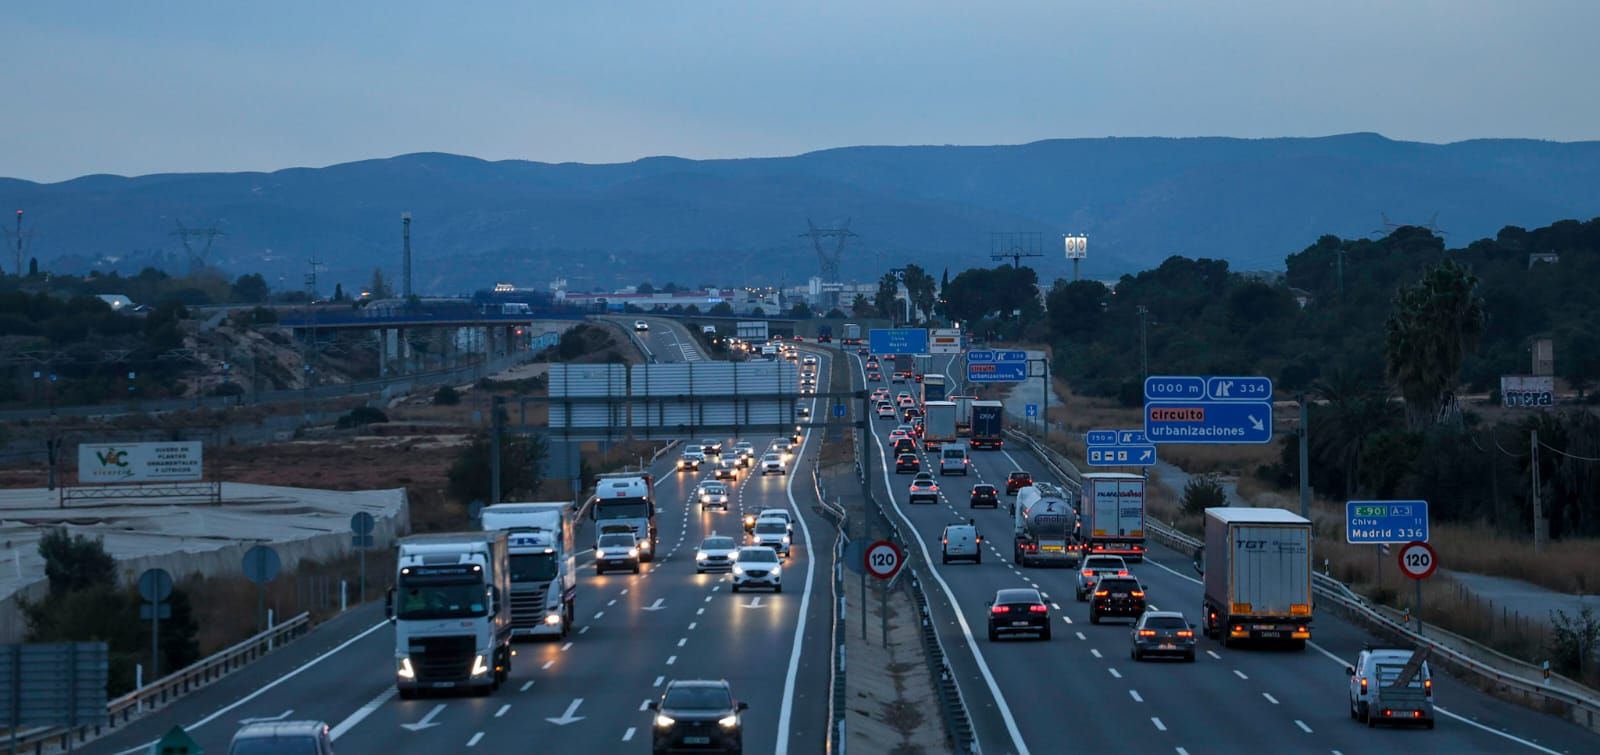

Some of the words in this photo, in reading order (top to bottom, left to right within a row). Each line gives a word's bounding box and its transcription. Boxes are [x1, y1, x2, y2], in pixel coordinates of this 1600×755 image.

[1152, 384, 1183, 393] 1000
[1189, 385, 1199, 393] m
[1240, 384, 1265, 393] 334
[1151, 408, 1204, 420] circuito
[1152, 425, 1245, 436] urbanizaciones
[1355, 507, 1386, 515] E-901
[1392, 507, 1410, 515] A-3
[1352, 518, 1377, 526] Chiva
[1352, 529, 1392, 538] Madrid
[1398, 529, 1423, 538] 336
[1235, 540, 1267, 549] TGT
[871, 553, 895, 566] 120
[1406, 553, 1430, 567] 120
